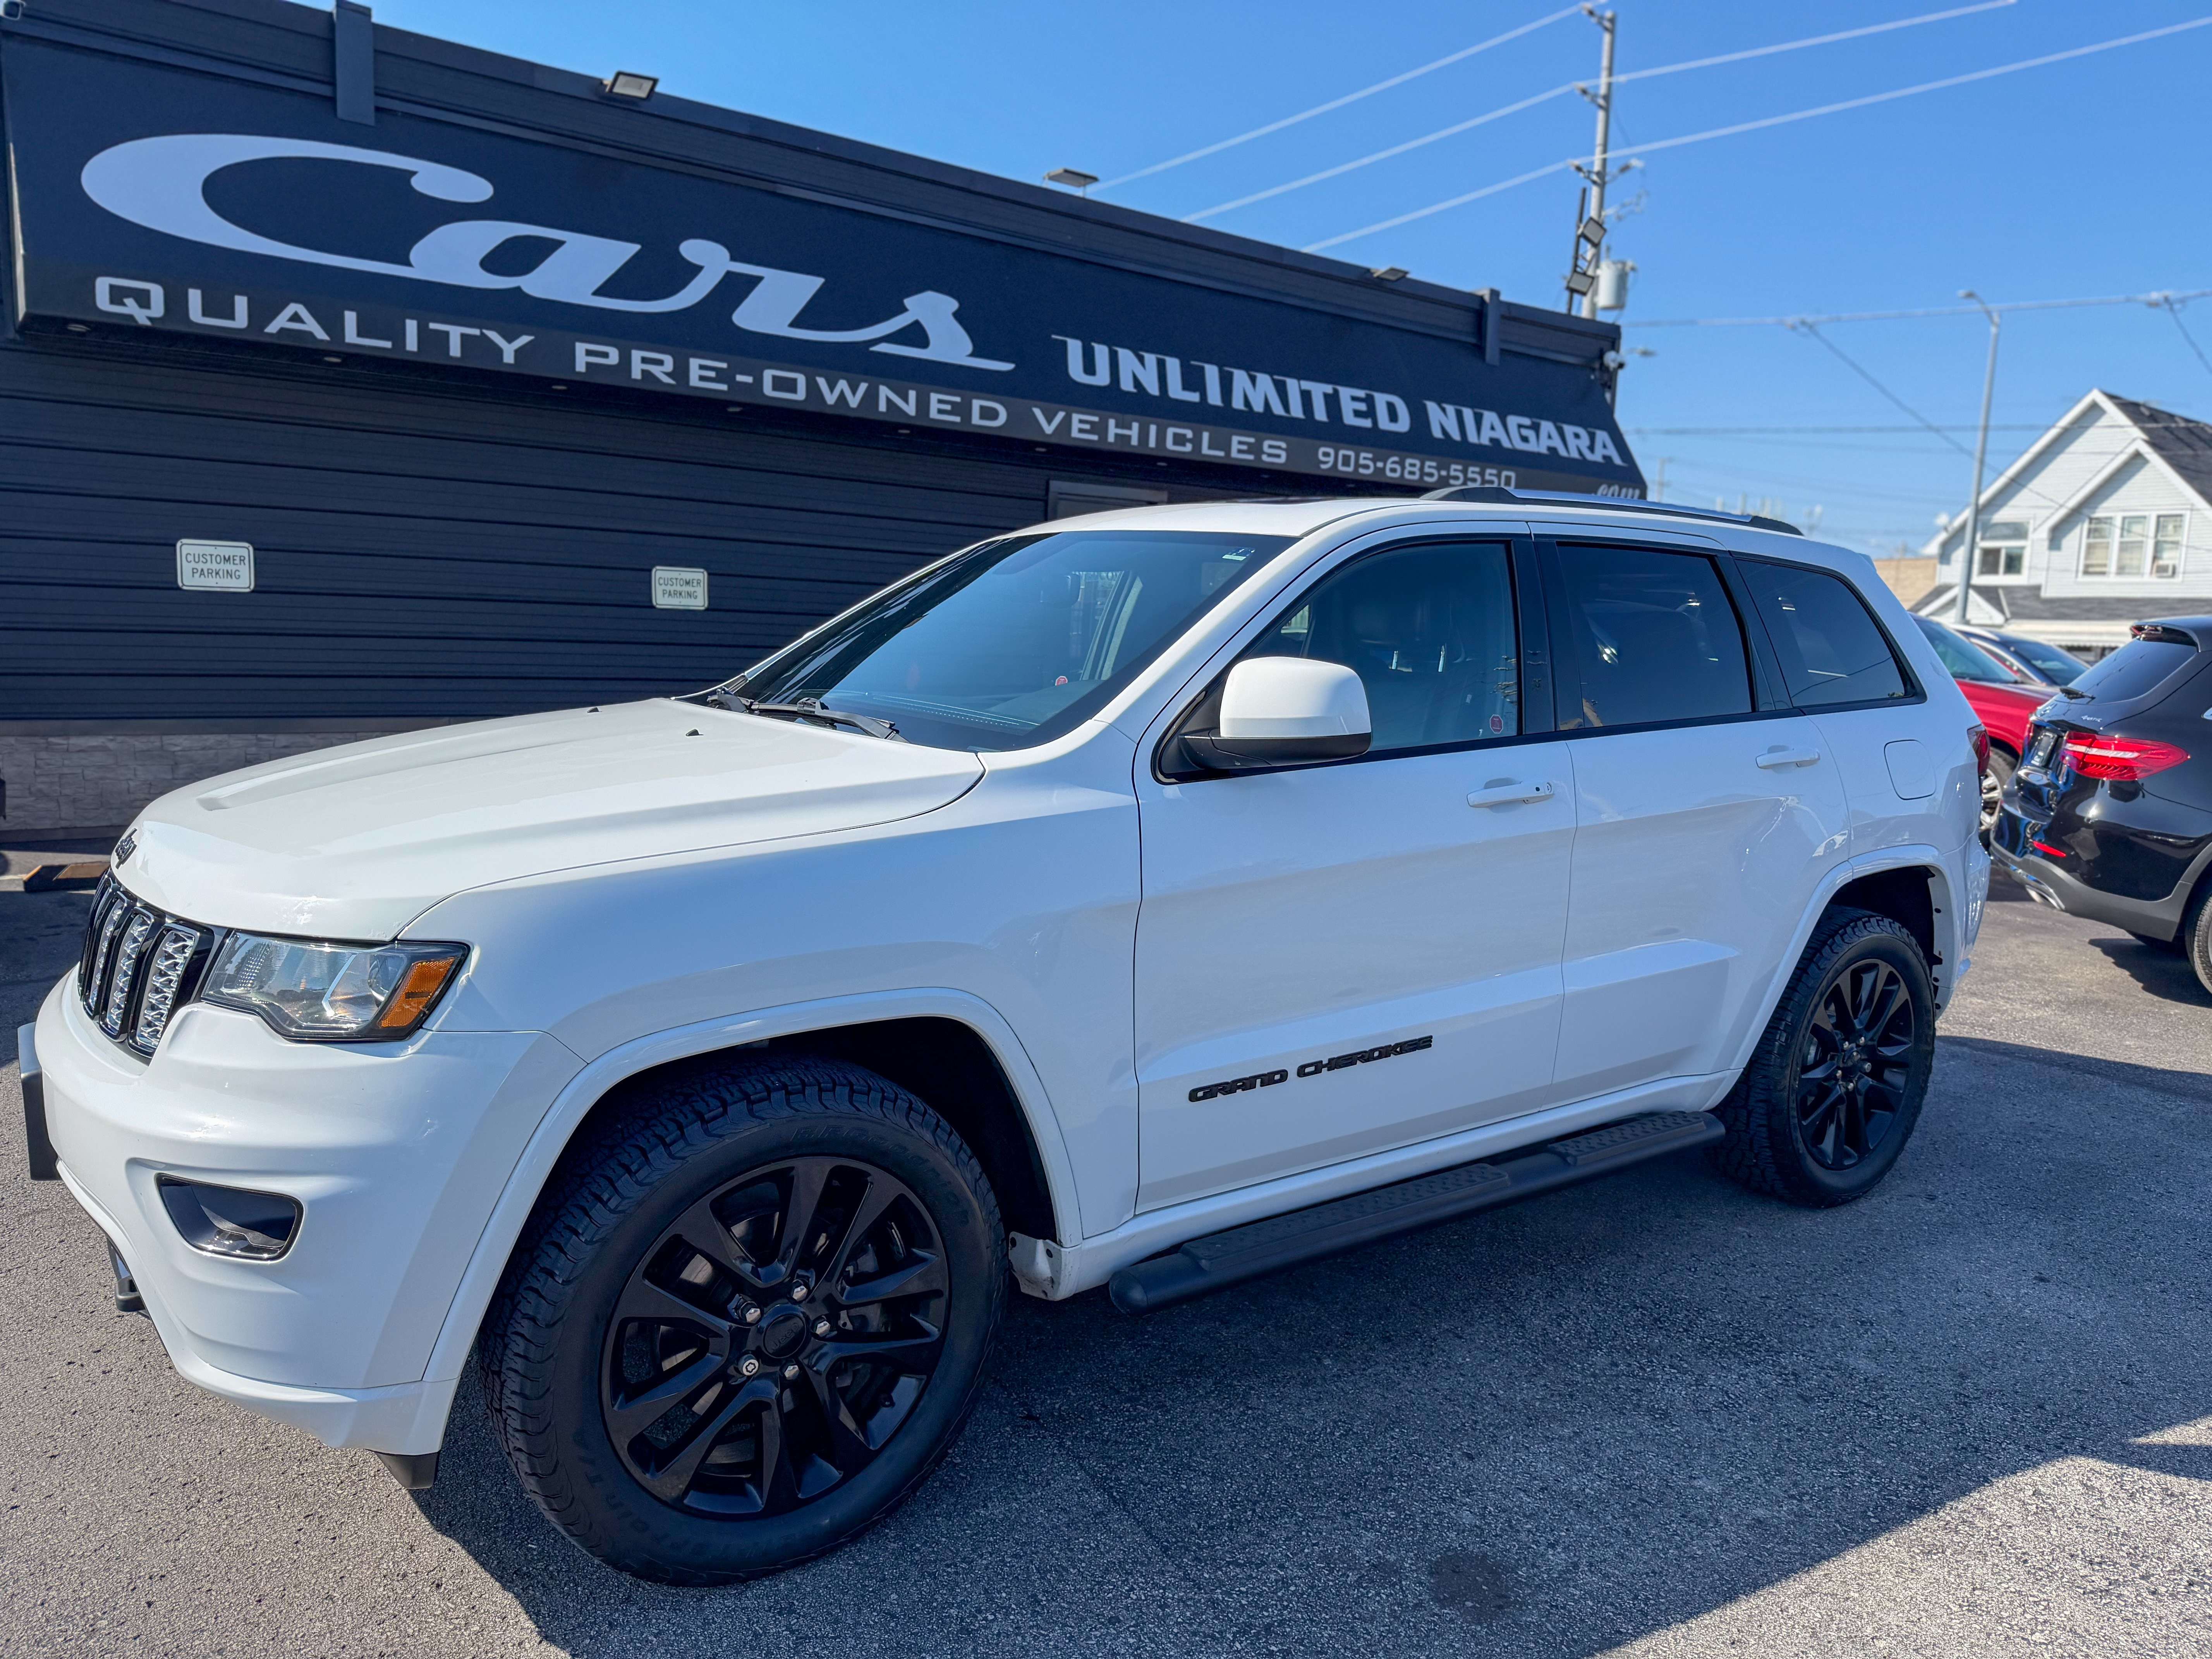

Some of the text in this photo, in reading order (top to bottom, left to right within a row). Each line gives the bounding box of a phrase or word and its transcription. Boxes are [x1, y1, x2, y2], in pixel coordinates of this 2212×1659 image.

[81, 134, 1628, 467] Cars UNLIMITED NIAGARA
[95, 276, 1288, 464] QUALITY PRE-OWNED VEHICLES
[1317, 447, 1516, 490] 905-685-5550
[185, 552, 246, 566] CUSTOMER
[191, 567, 240, 580] PARKING
[658, 576, 702, 587] CUSTOMER
[662, 589, 698, 599] PARKING
[1188, 1034, 1433, 1103] GRAND CHEROKEE
